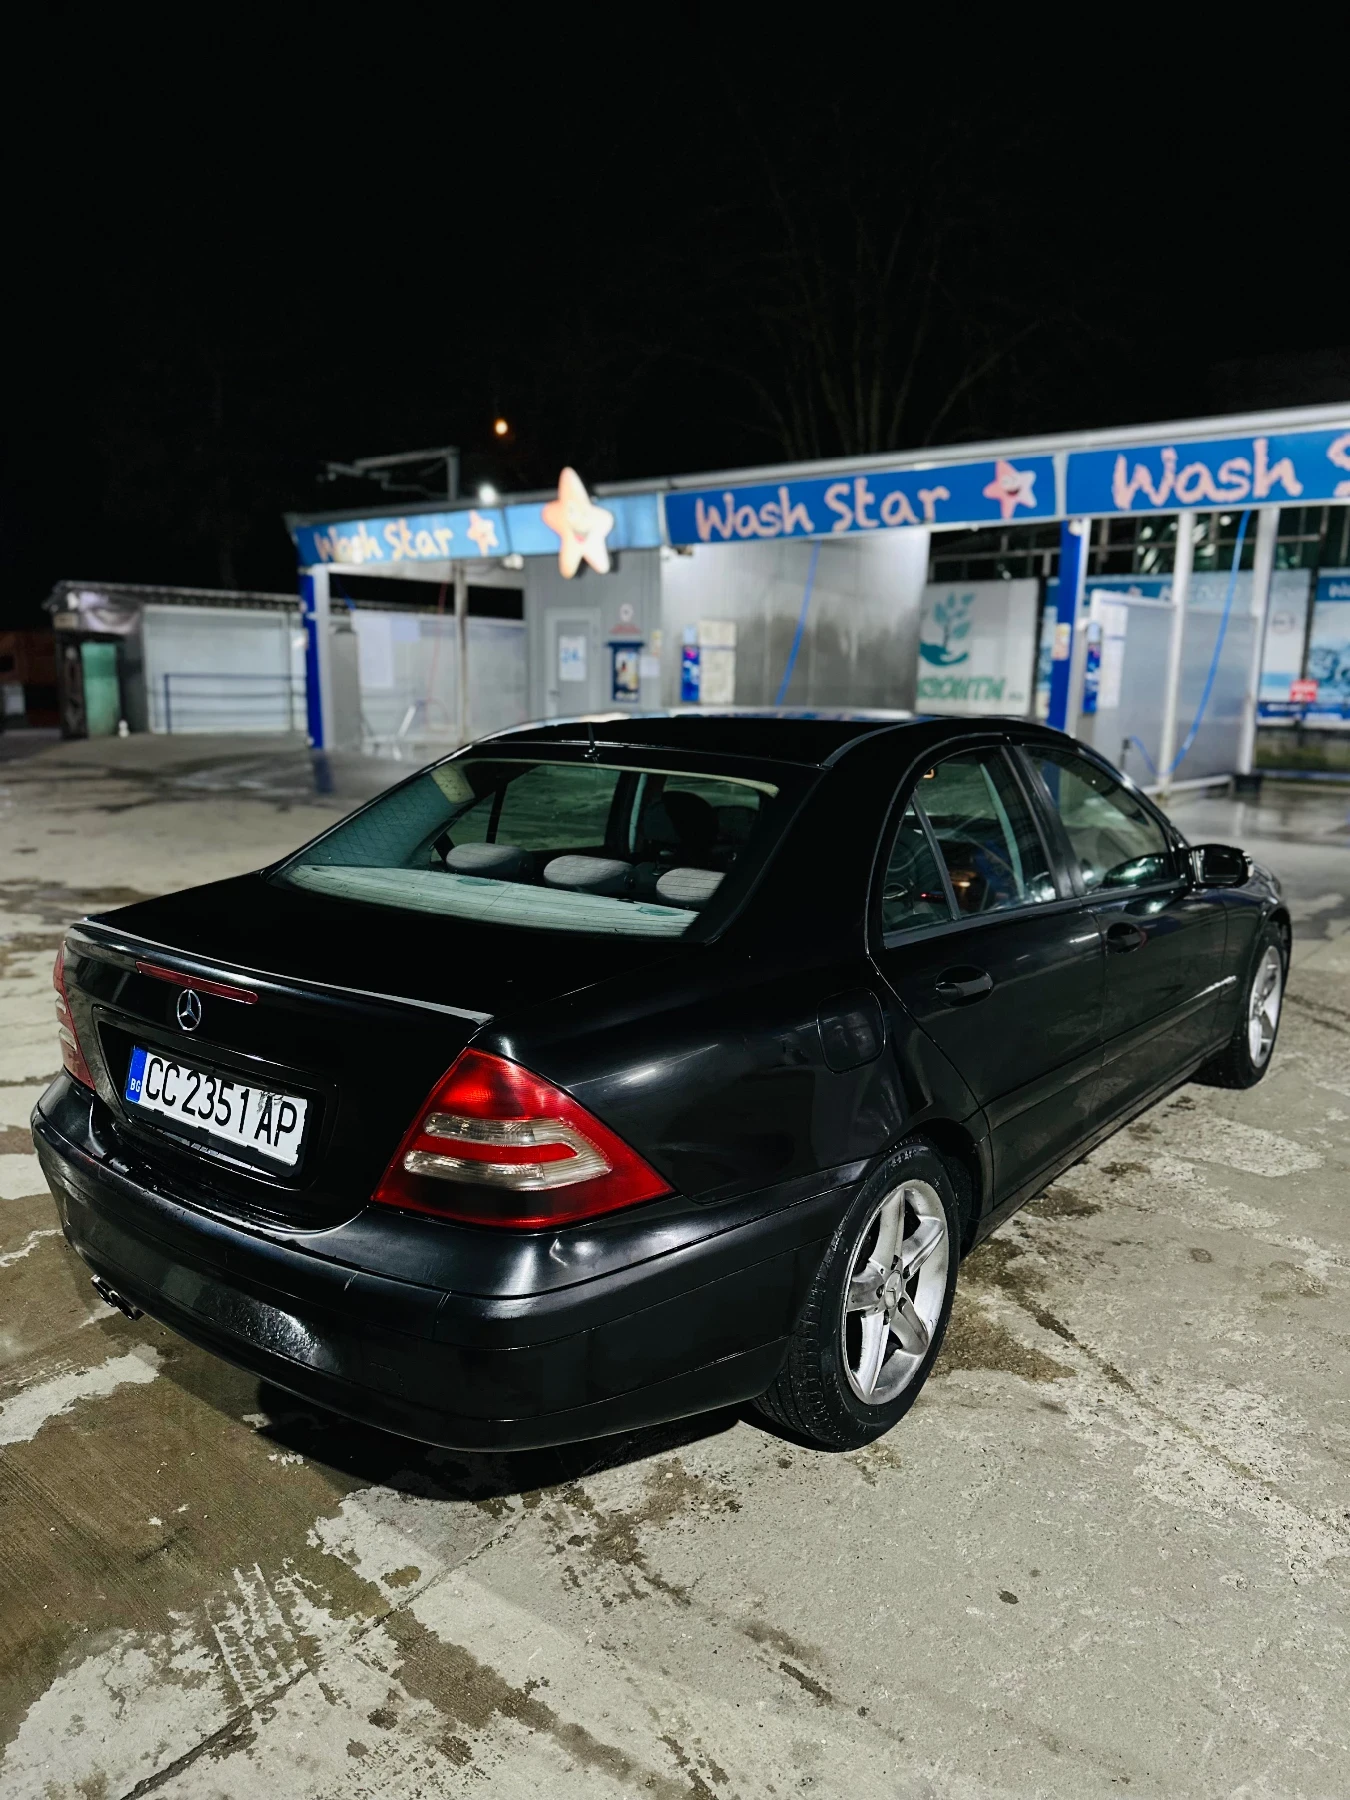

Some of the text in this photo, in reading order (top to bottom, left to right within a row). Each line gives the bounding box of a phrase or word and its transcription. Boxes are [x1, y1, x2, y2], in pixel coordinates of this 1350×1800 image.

[1112, 437, 1304, 511] Wash
[695, 477, 951, 542] Wash Star
[384, 517, 454, 562] Star
[129, 1077, 142, 1093] BG
